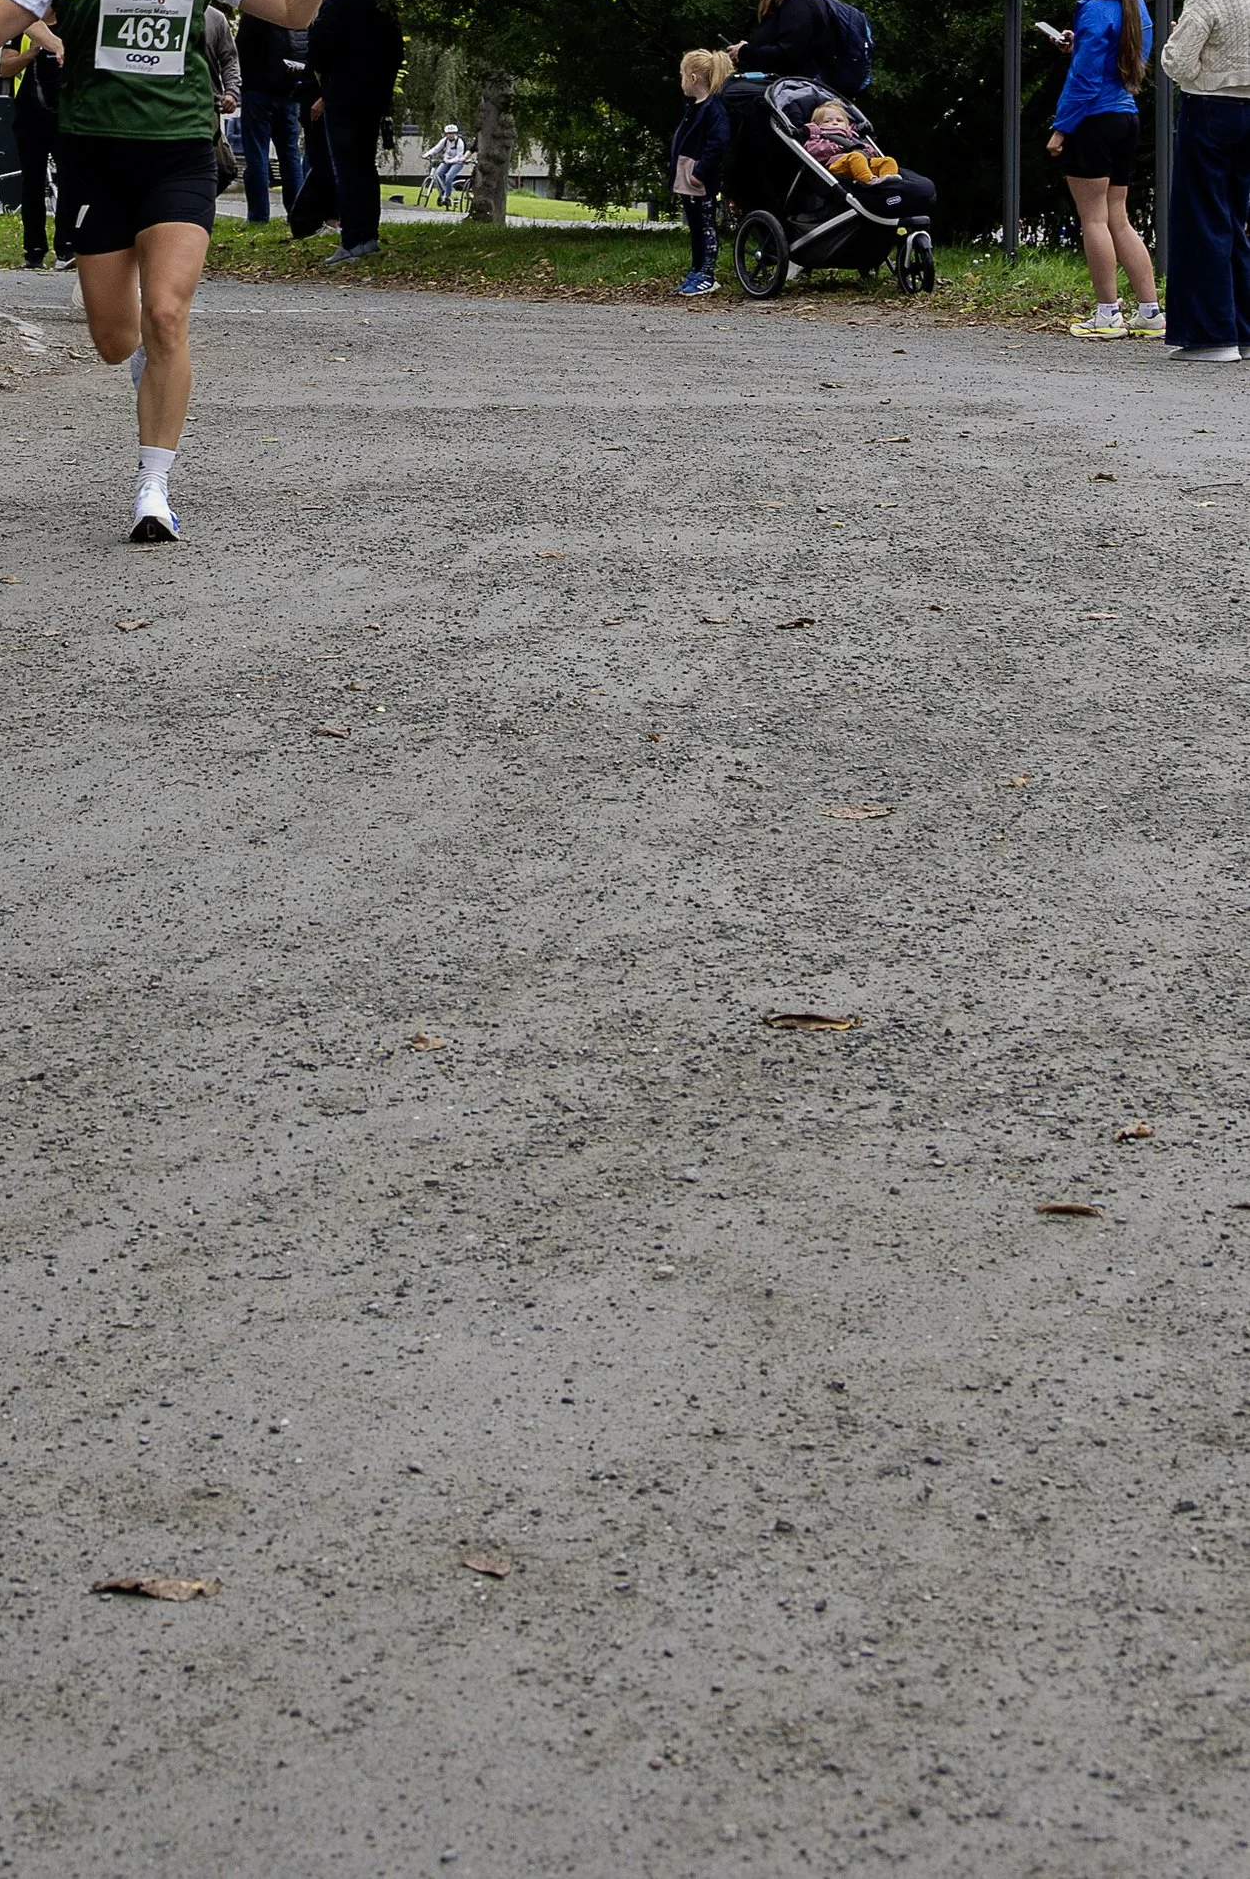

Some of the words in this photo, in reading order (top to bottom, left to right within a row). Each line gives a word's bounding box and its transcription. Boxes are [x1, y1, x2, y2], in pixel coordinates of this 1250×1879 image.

[118, 16, 171, 50] 463
[174, 34, 181, 49] 1
[126, 53, 160, 66] coop
